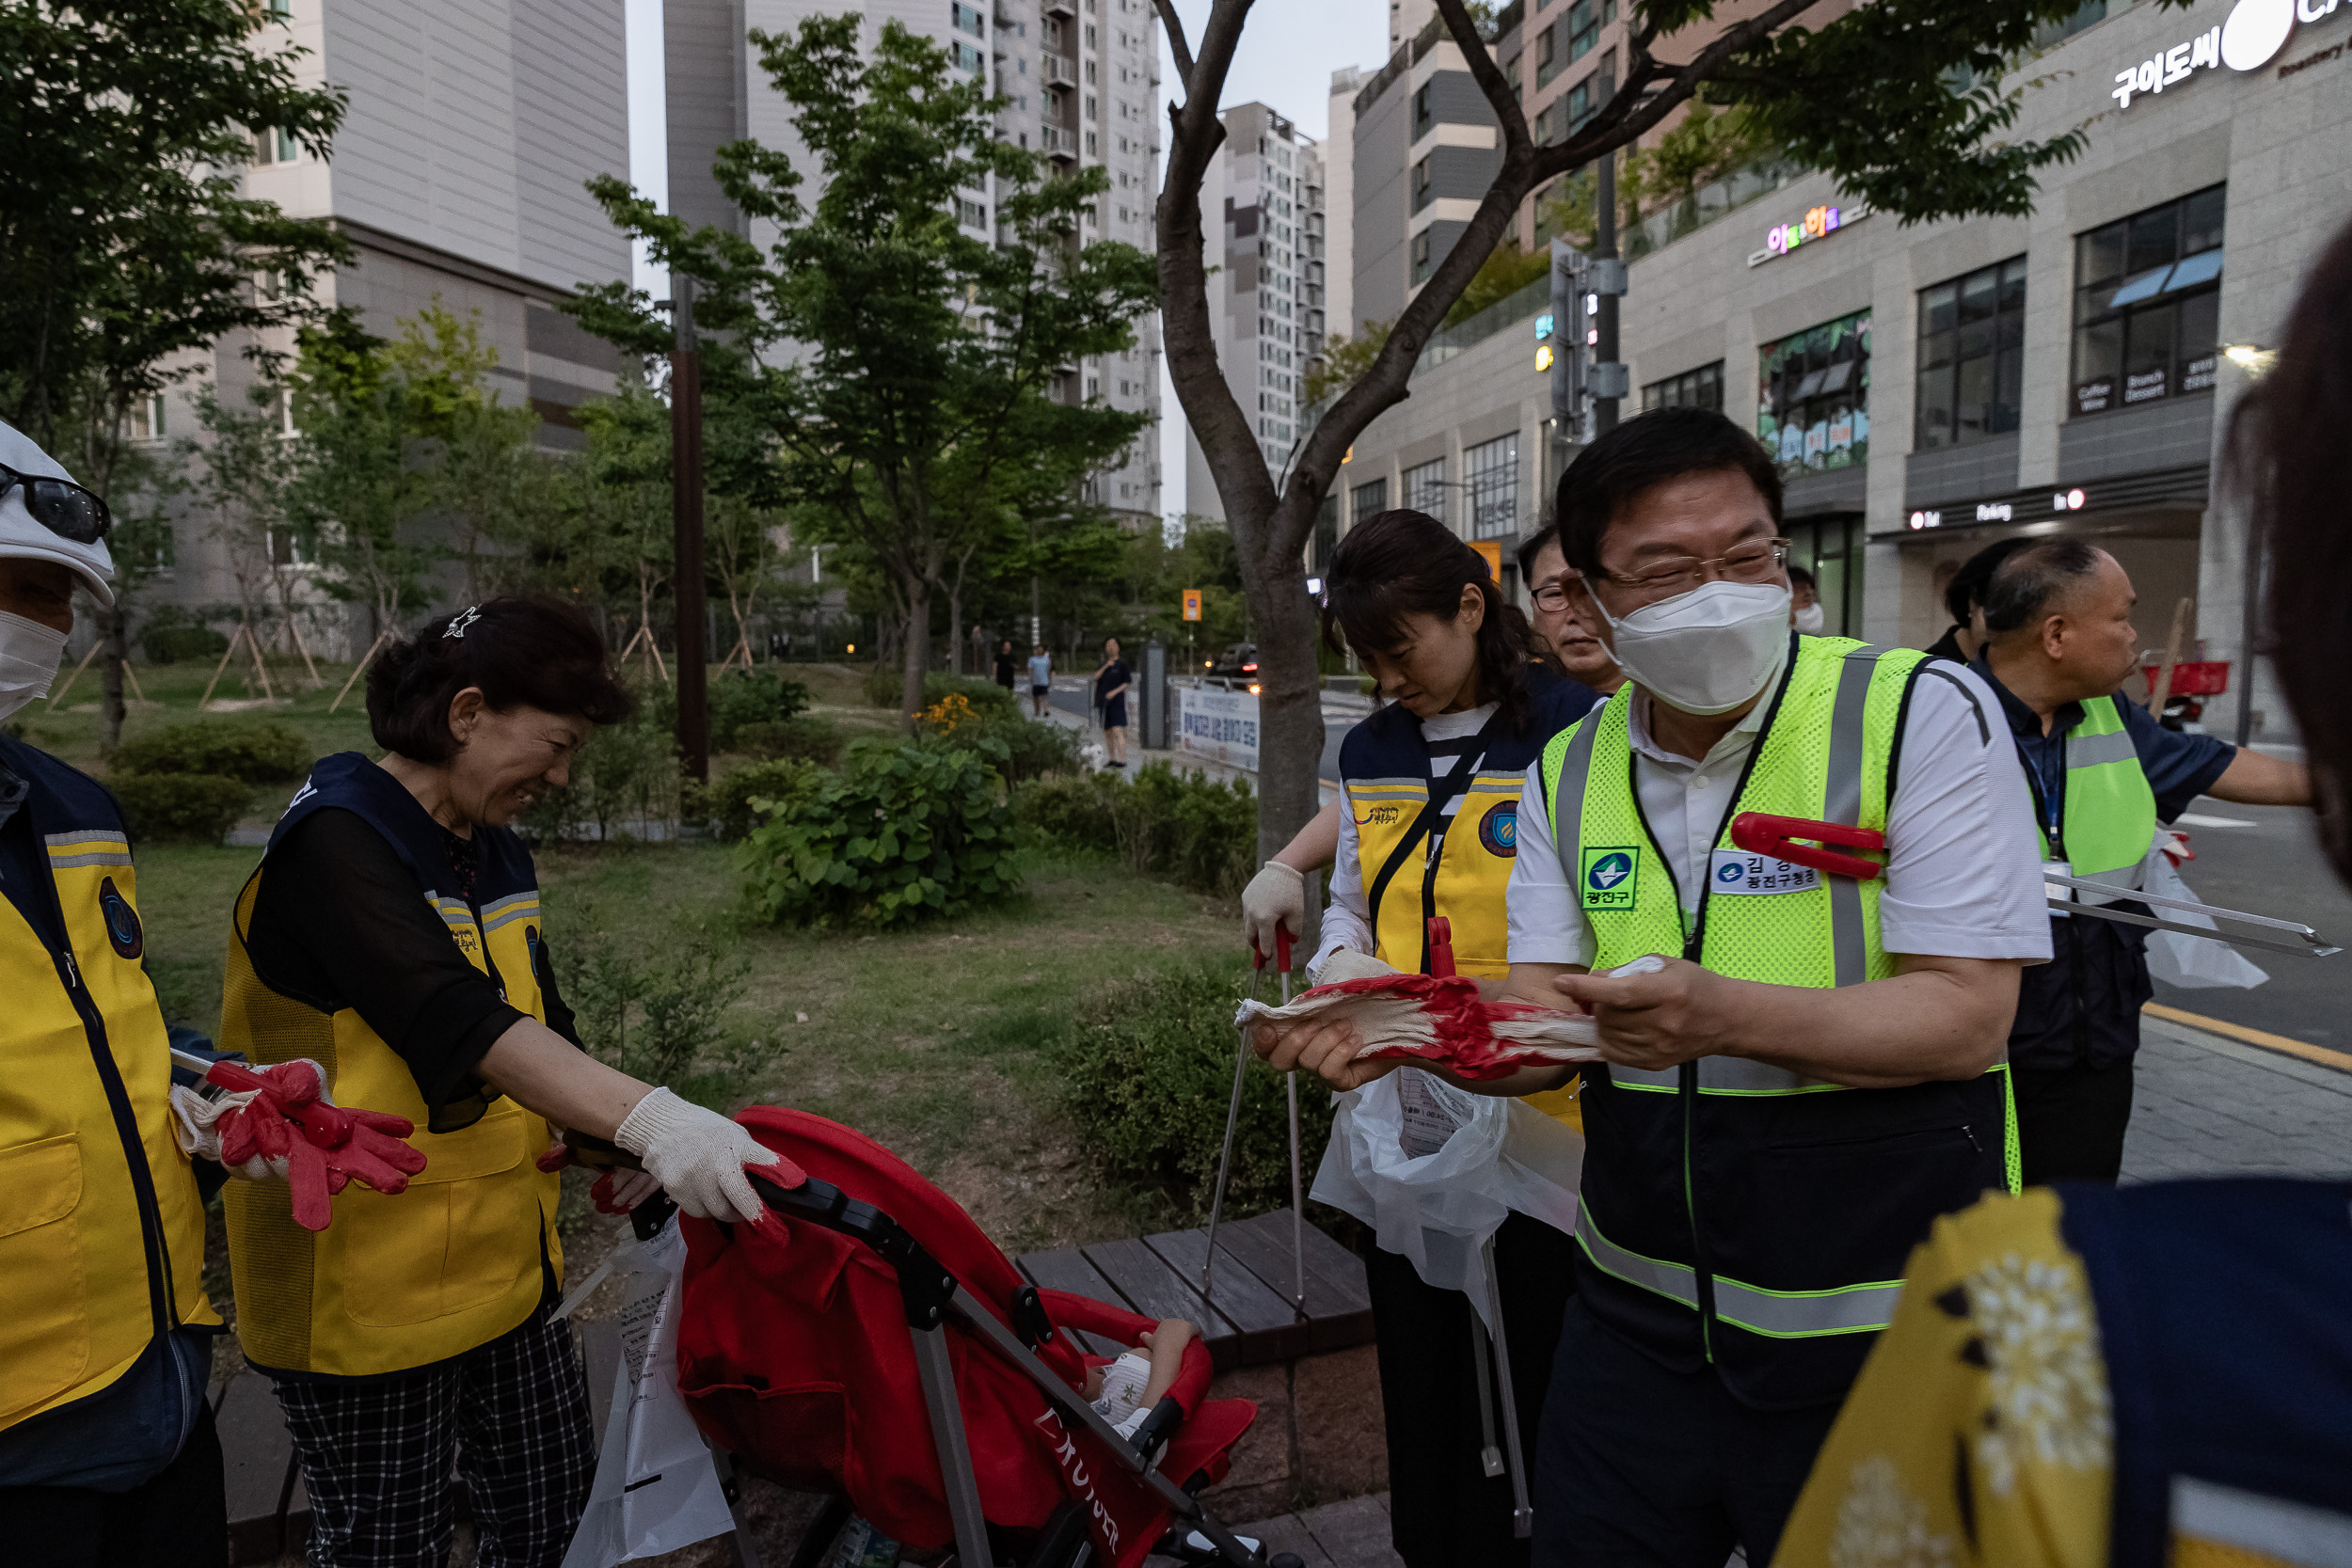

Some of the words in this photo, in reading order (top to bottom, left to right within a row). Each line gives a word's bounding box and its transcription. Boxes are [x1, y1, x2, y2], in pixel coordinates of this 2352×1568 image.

[2112, 25, 2220, 108] 구이도씨
[1924, 511, 1940, 527] Out
[1977, 503, 2011, 521] Parking
[2054, 494, 2067, 511] In
[1747, 857, 1763, 873] 김
[1586, 892, 1630, 905] 광진구
